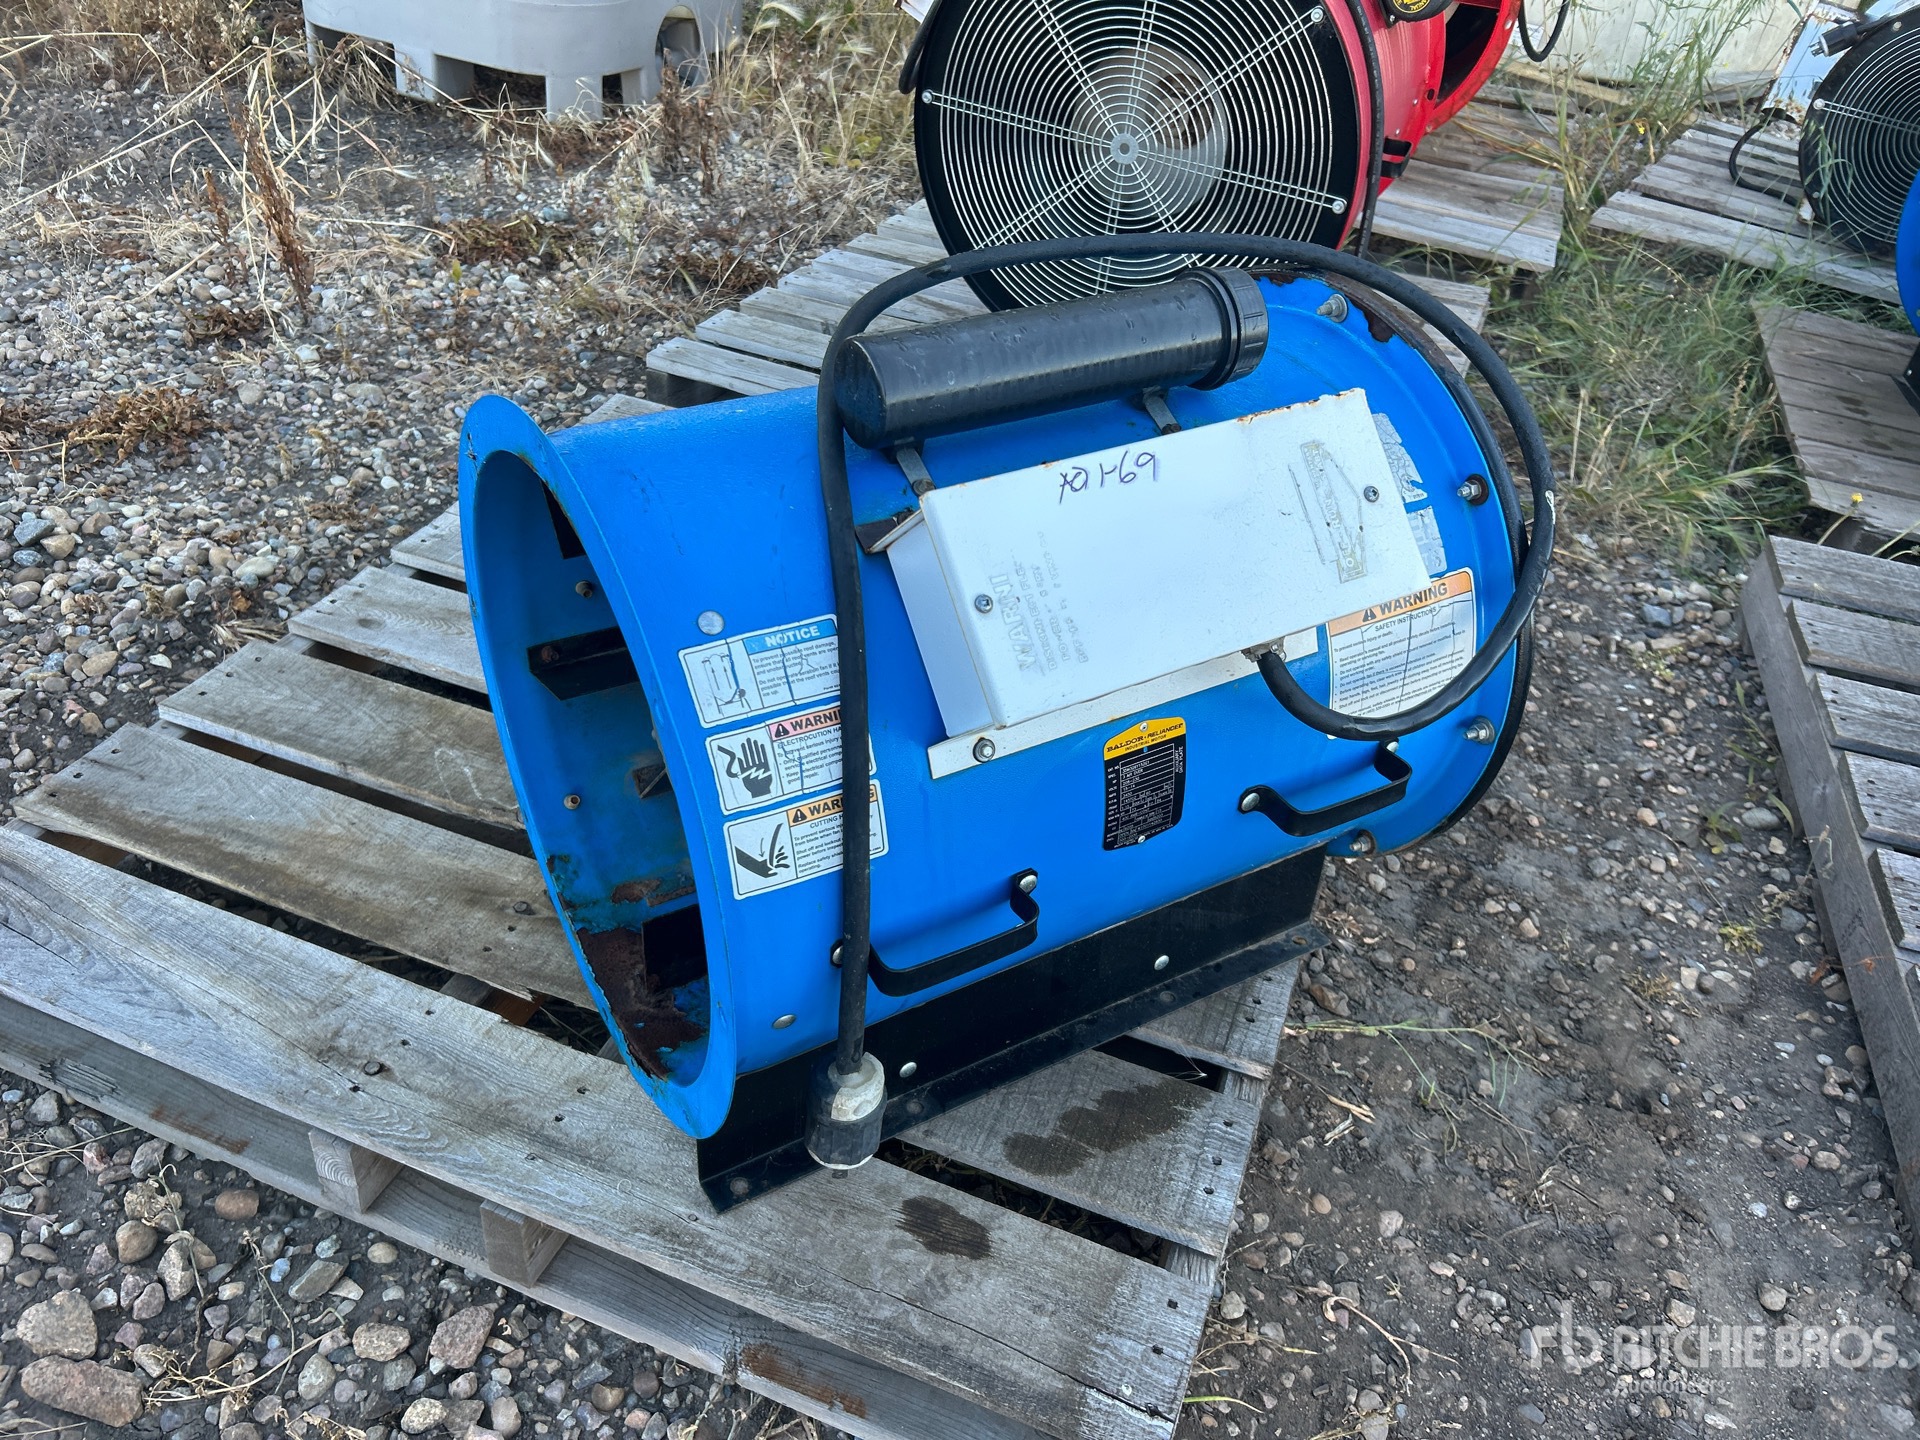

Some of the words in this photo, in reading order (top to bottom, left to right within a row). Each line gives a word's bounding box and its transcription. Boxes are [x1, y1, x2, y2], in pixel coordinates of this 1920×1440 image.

[1380, 583, 1448, 616] WARNING
[1375, 619, 1396, 632] SAFETY
[1397, 606, 1436, 625] INSTRUCTIONS
[764, 624, 820, 647] NOTICE
[754, 661, 771, 669] ensure
[803, 650, 817, 658] vents
[759, 653, 778, 663] prevent
[760, 682, 781, 691] possible
[790, 710, 841, 731] WARNI
[777, 728, 831, 748] ELECTROCUTION
[824, 736, 838, 744] injury
[1107, 735, 1143, 752] BALDOR
[1125, 739, 1149, 751] INDUSTRIAL
[1151, 734, 1166, 742] MOTOR
[805, 755, 826, 764] electrical
[809, 815, 837, 828] CUTTING
[800, 830, 817, 840] prevent
[818, 825, 834, 833] serious
[824, 837, 841, 845] lockout
[796, 852, 810, 860] power
[798, 859, 816, 868] Replace
[799, 863, 820, 873] operating.
